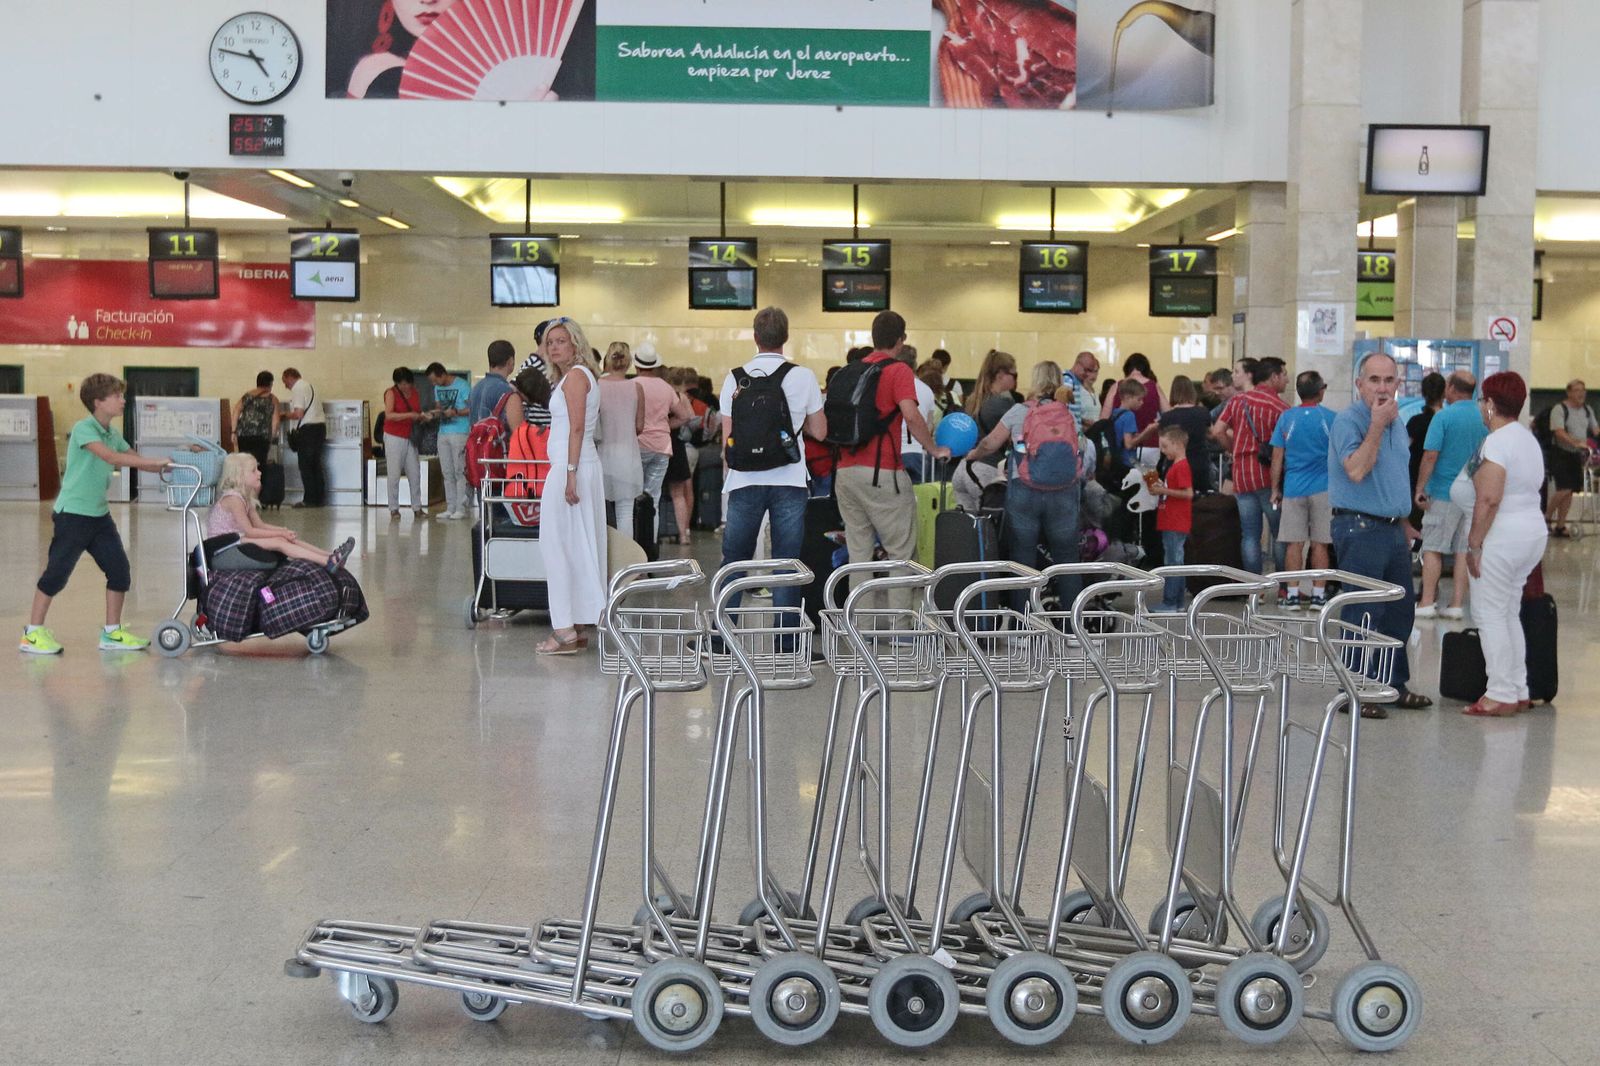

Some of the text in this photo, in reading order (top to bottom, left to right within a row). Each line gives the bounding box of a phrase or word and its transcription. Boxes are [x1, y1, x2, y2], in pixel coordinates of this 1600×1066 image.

[236, 24, 245, 34] 11
[250, 20, 261, 31] 12
[270, 25, 275, 35] 1
[223, 37, 235, 47] 10
[281, 37, 288, 47] 2
[287, 54, 294, 64] 3
[617, 41, 911, 66] Saborea Andalucía en el aeropuerto...
[223, 68, 230, 78] 8
[281, 70, 288, 80] 4
[687, 59, 832, 83] empieza por Jerez
[235, 81, 242, 91] 7
[252, 86, 258, 96] 6
[268, 82, 275, 92] 5
[168, 234, 198, 255] 11
[310, 235, 340, 257] 12
[511, 241, 540, 262] 13
[707, 244, 738, 265] 14
[842, 246, 871, 267] 15
[1039, 247, 1069, 269] 16
[1168, 251, 1197, 272] 17
[1361, 255, 1390, 276] 18
[238, 269, 290, 280] IBERIA
[324, 275, 345, 283] aena
[96, 308, 174, 324] Facturación
[96, 325, 152, 340] Check-in
